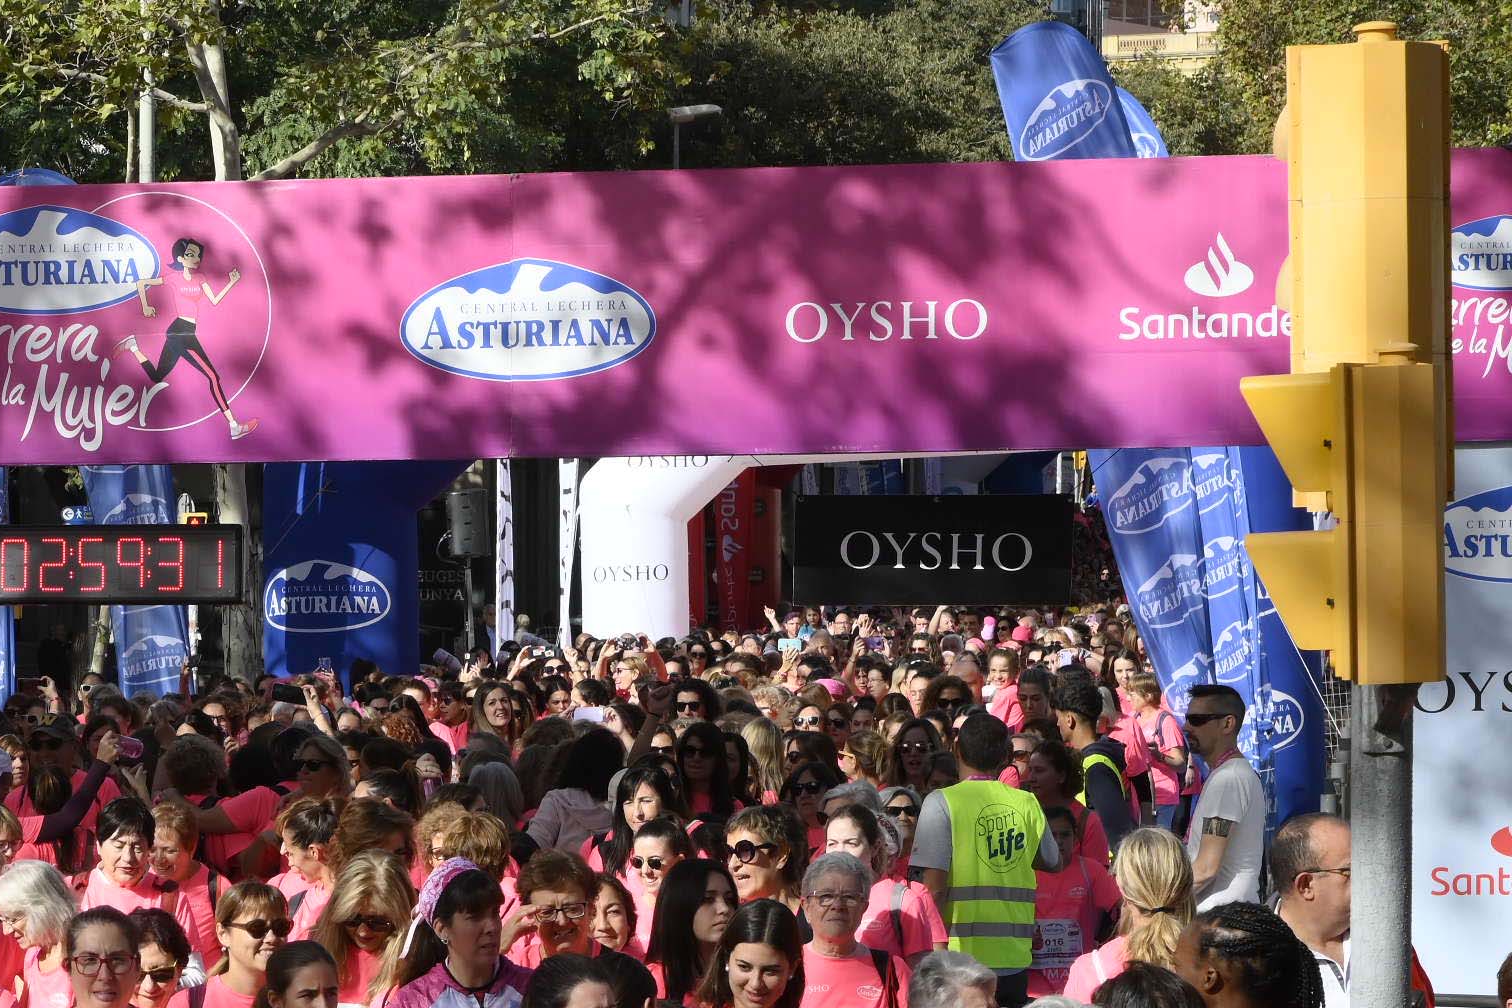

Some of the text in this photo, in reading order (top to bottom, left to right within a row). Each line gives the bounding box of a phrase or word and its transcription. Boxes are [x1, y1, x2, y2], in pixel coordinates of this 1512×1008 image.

[63, 241, 136, 253] LECHERA
[460, 299, 628, 315] CENTRAL LECHERA
[785, 299, 988, 343] OYSHO
[1119, 305, 1293, 340] Santande
[420, 307, 636, 350] ASTURIANA
[1469, 327, 1488, 355] la
[1, 365, 26, 406] la
[21, 358, 170, 452] Mujer
[0, 537, 223, 592] 02:59:31
[840, 530, 1033, 571] OYSHO
[593, 564, 669, 583] OYSHO
[269, 590, 381, 617] ASTURIANA
[978, 809, 1017, 837] Sport
[987, 827, 1025, 862] Life
